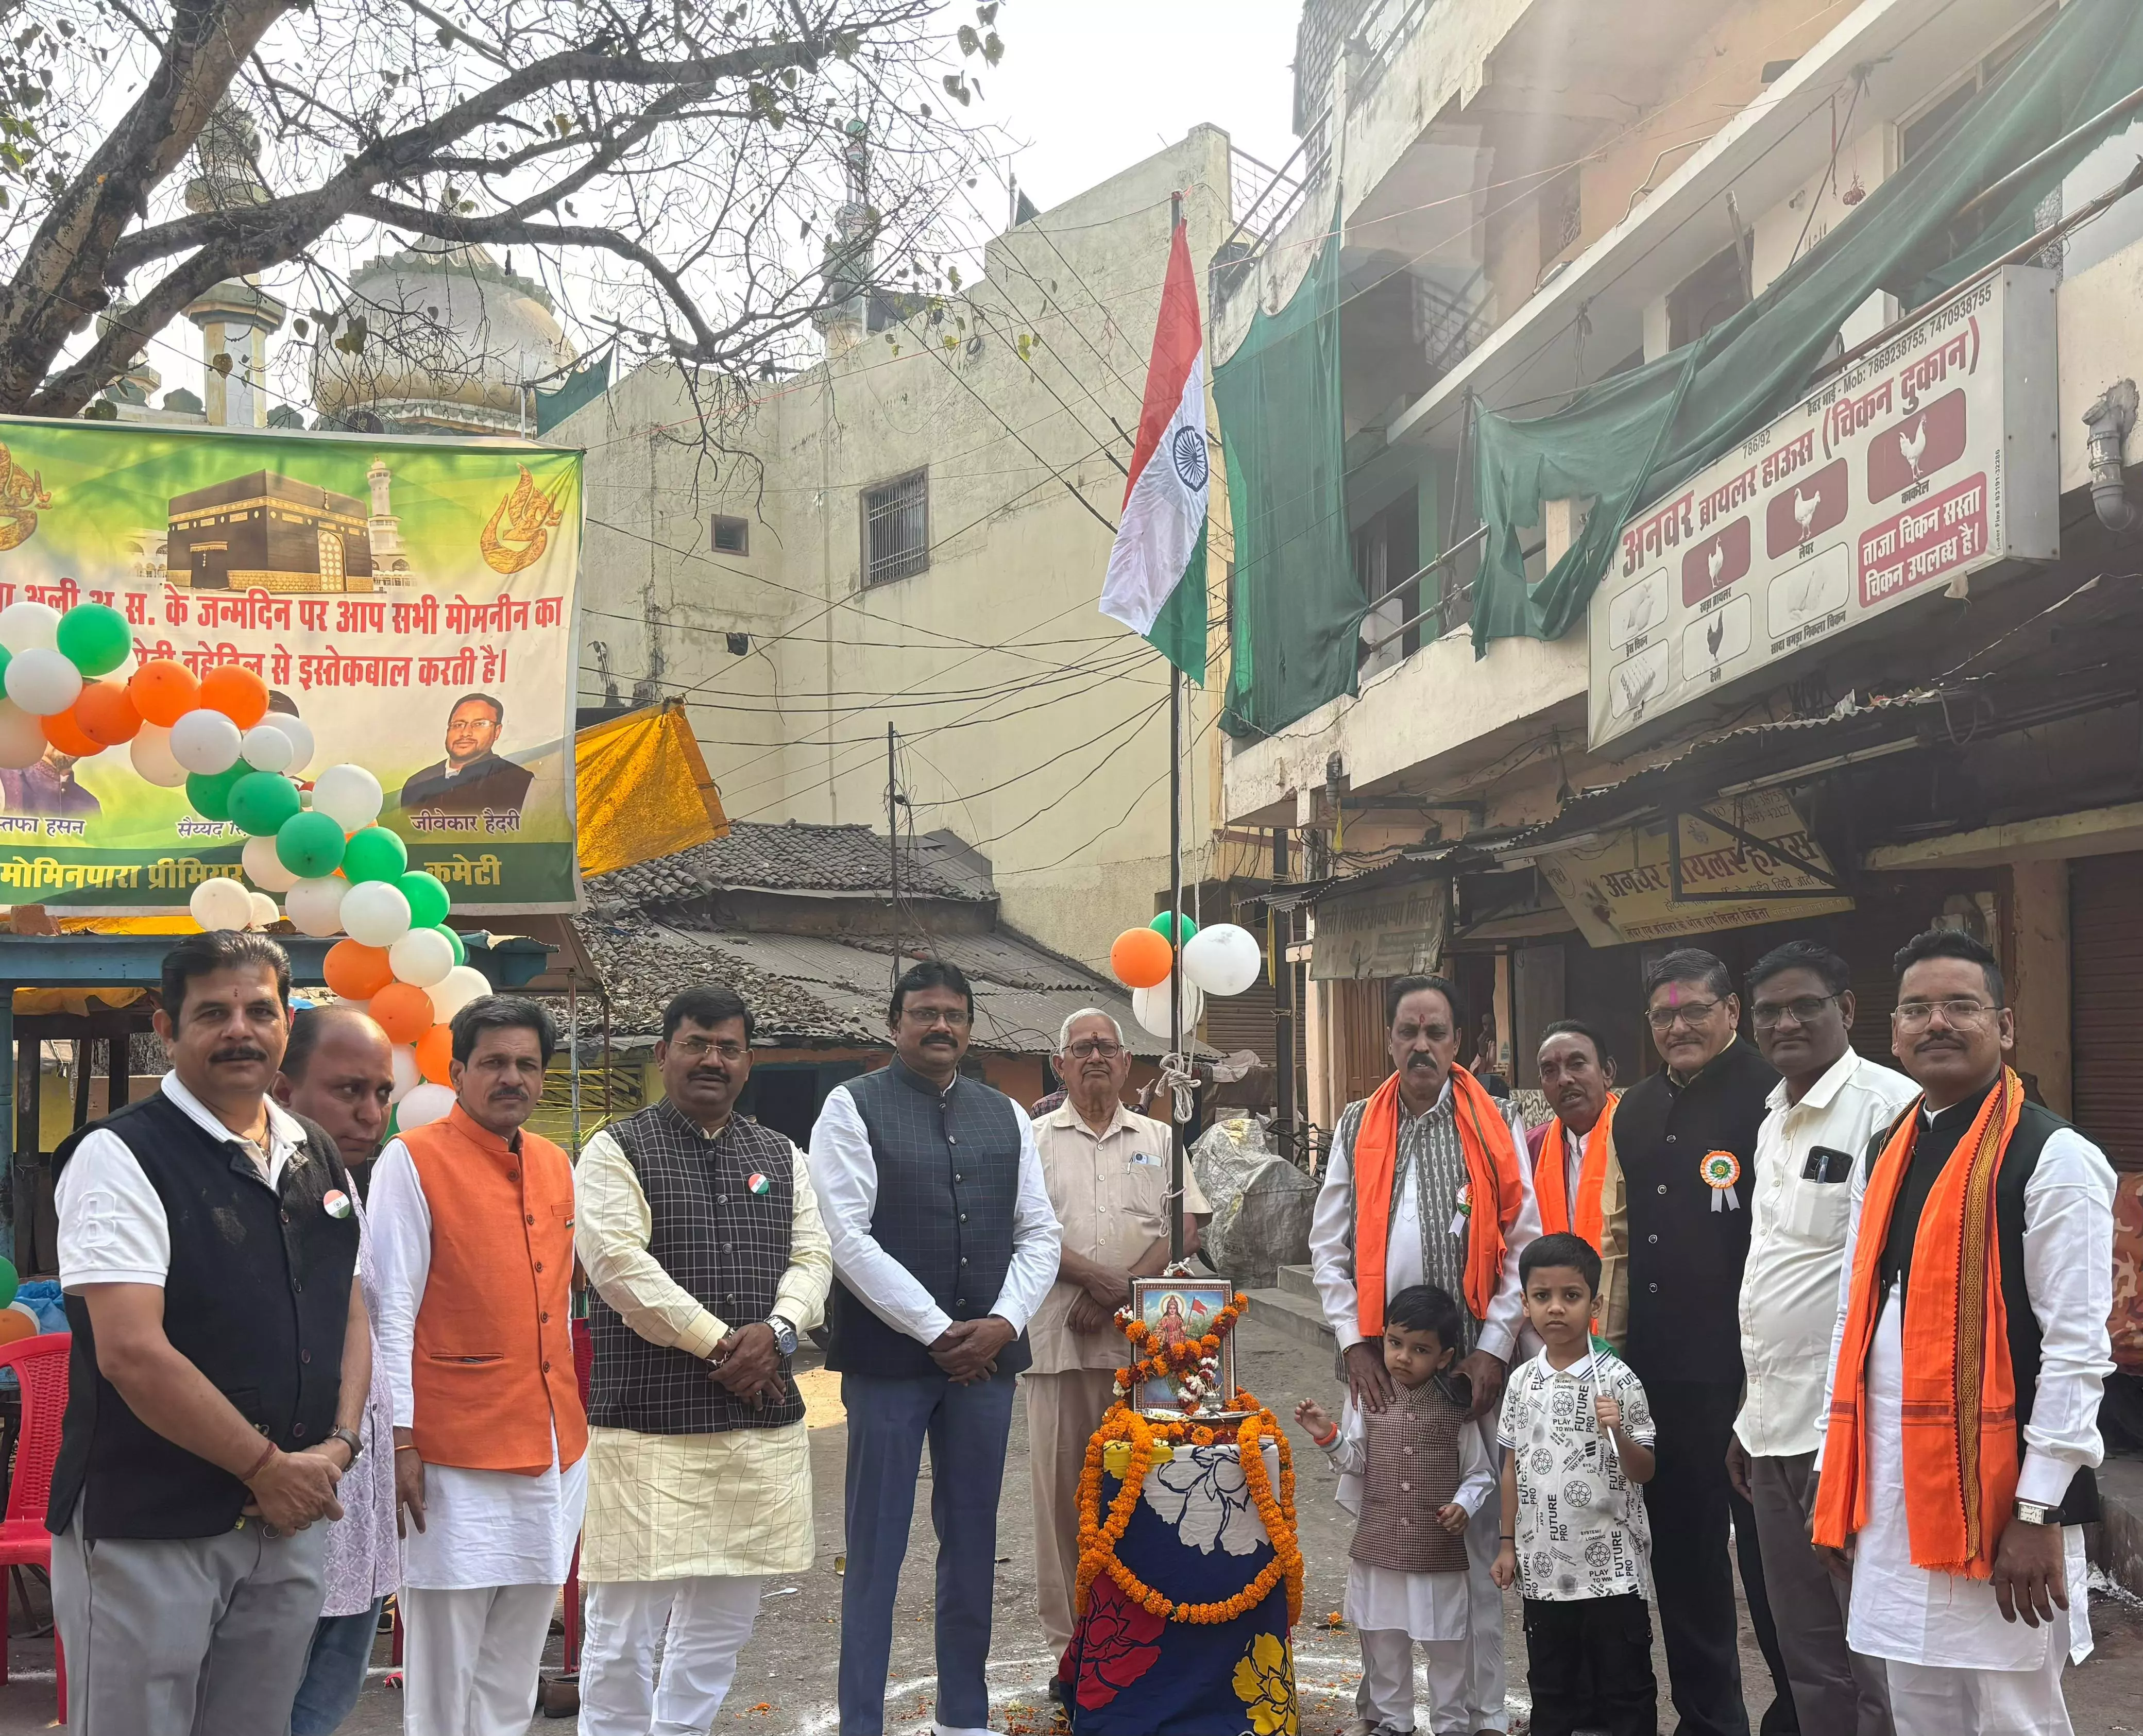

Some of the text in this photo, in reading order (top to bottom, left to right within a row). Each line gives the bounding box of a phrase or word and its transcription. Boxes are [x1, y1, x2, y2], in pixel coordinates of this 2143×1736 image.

[1844, 372, 1866, 394] Mob:
[1868, 327, 1927, 378] 7869238755,
[1930, 283, 1992, 338] 7470938755
[1623, 315, 1980, 578] अनवर ब्रायलर हाऊस (चिकन दुकान)
[1743, 429, 1771, 459] 786/92
[1862, 485, 1982, 566] ताजा चिकन सस्ता
[1798, 541, 1814, 559] लेयर
[1865, 561, 1904, 601] चिकन
[1907, 536, 1958, 581] उपलब्ध
[164, 584, 190, 626] के
[196, 588, 293, 631] जन्मदिन
[298, 600, 329, 632] पर
[336, 601, 386, 633] आप
[392, 594, 439, 635] सभी
[445, 593, 531, 635] मोमनीन
[535, 596, 564, 627] का
[1827, 610, 1846, 629] चिकन
[271, 643, 293, 685] से
[298, 644, 413, 691] इस्तेकबाल
[418, 646, 478, 686] करती
[46, 820, 86, 836] हसन
[410, 808, 521, 833] जीवेकार हैदरी
[0, 856, 142, 889] मोमिनपारा
[423, 854, 503, 886] कमेटी
[1574, 1385, 1589, 1432] FUTURE
[1586, 1416, 1595, 1433] PRO
[1529, 1487, 1538, 1505] PRO
[1618, 1475, 1627, 1491] PRO
[1547, 1494, 1559, 1541] FUTURE
[1559, 1524, 1569, 1541] PRO
[1611, 1530, 1624, 1578] FUTURE
[1625, 1559, 1634, 1577] PRO
[1523, 1552, 1533, 1598] FUTURE
[1589, 1569, 1609, 1577] PLAY
